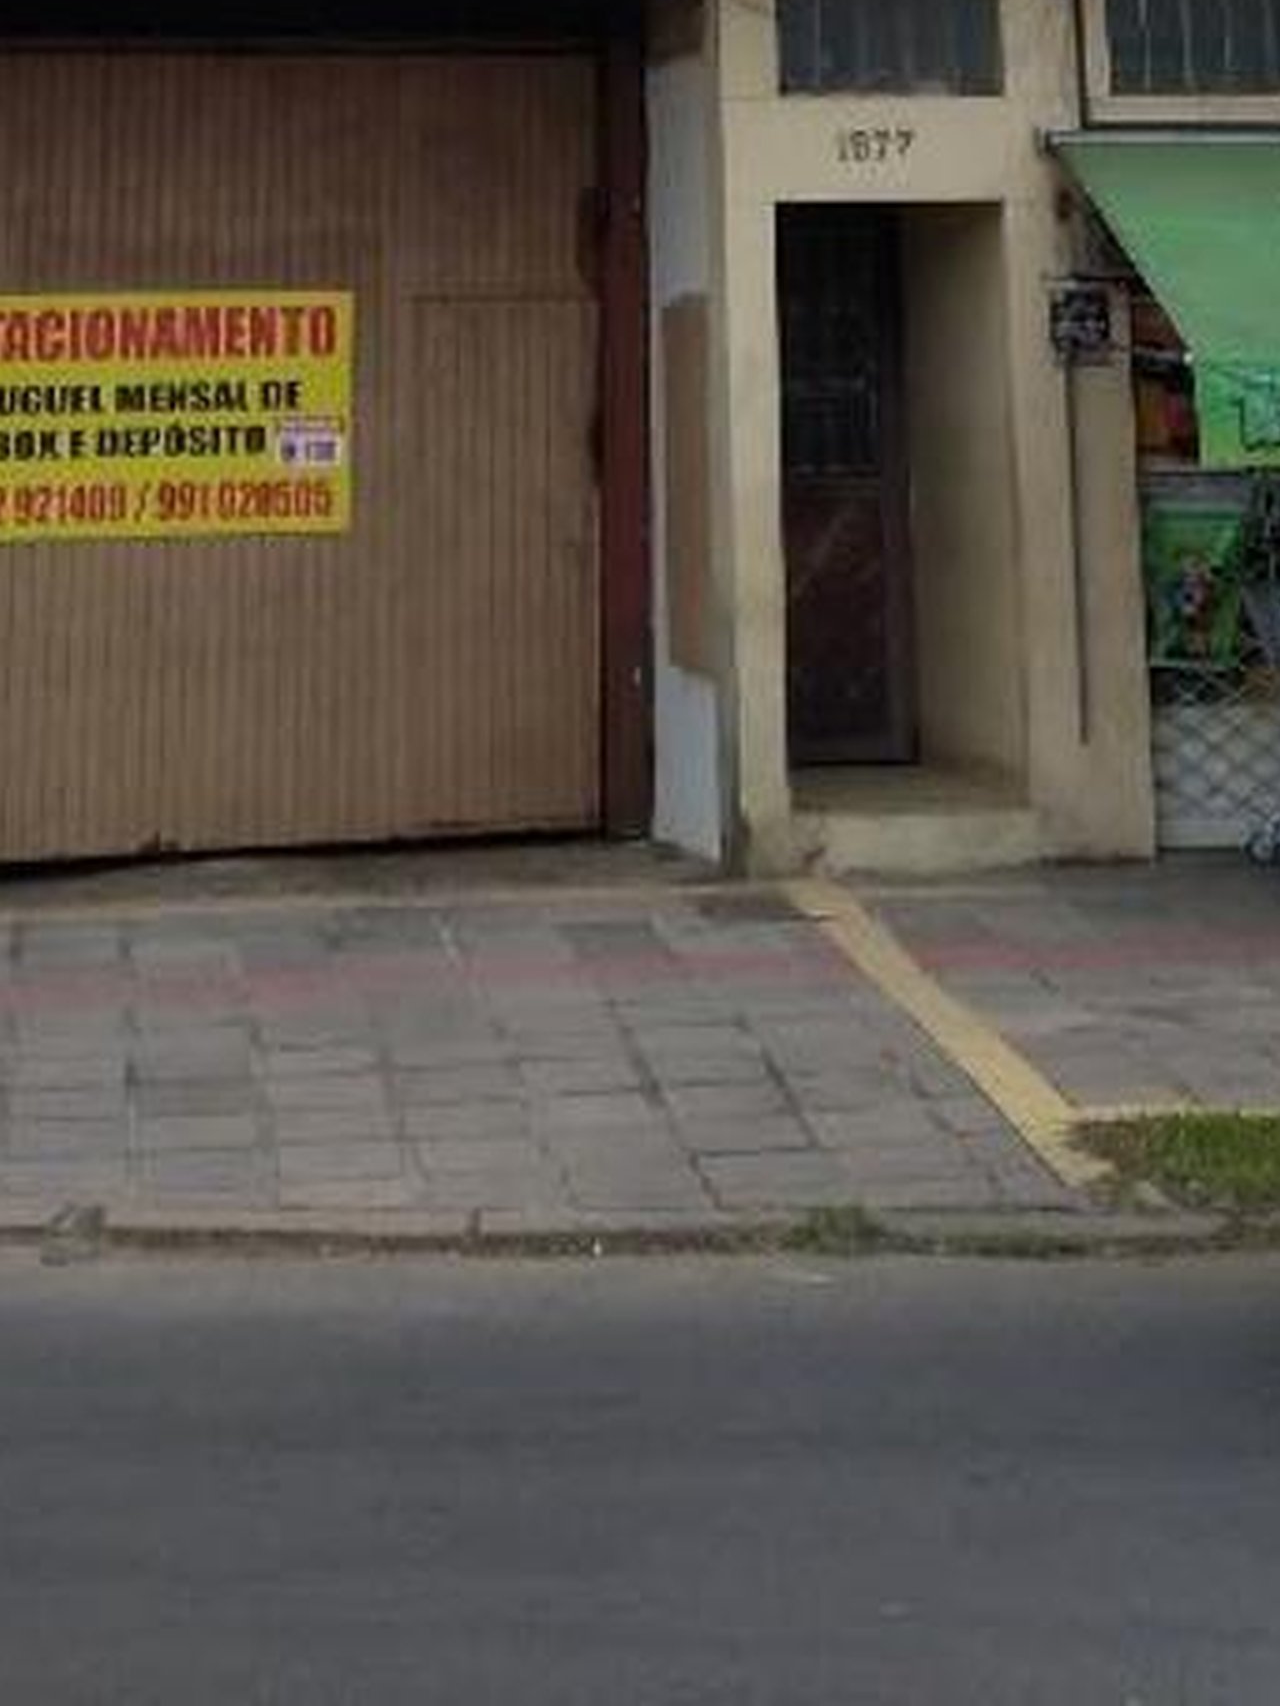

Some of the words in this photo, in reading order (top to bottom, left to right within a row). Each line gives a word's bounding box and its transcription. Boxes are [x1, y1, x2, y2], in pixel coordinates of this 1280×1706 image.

[114, 380, 248, 413] MENSAL
[261, 379, 303, 410] DE
[69, 429, 87, 459] E
[96, 417, 267, 458] DEPÓSITO
